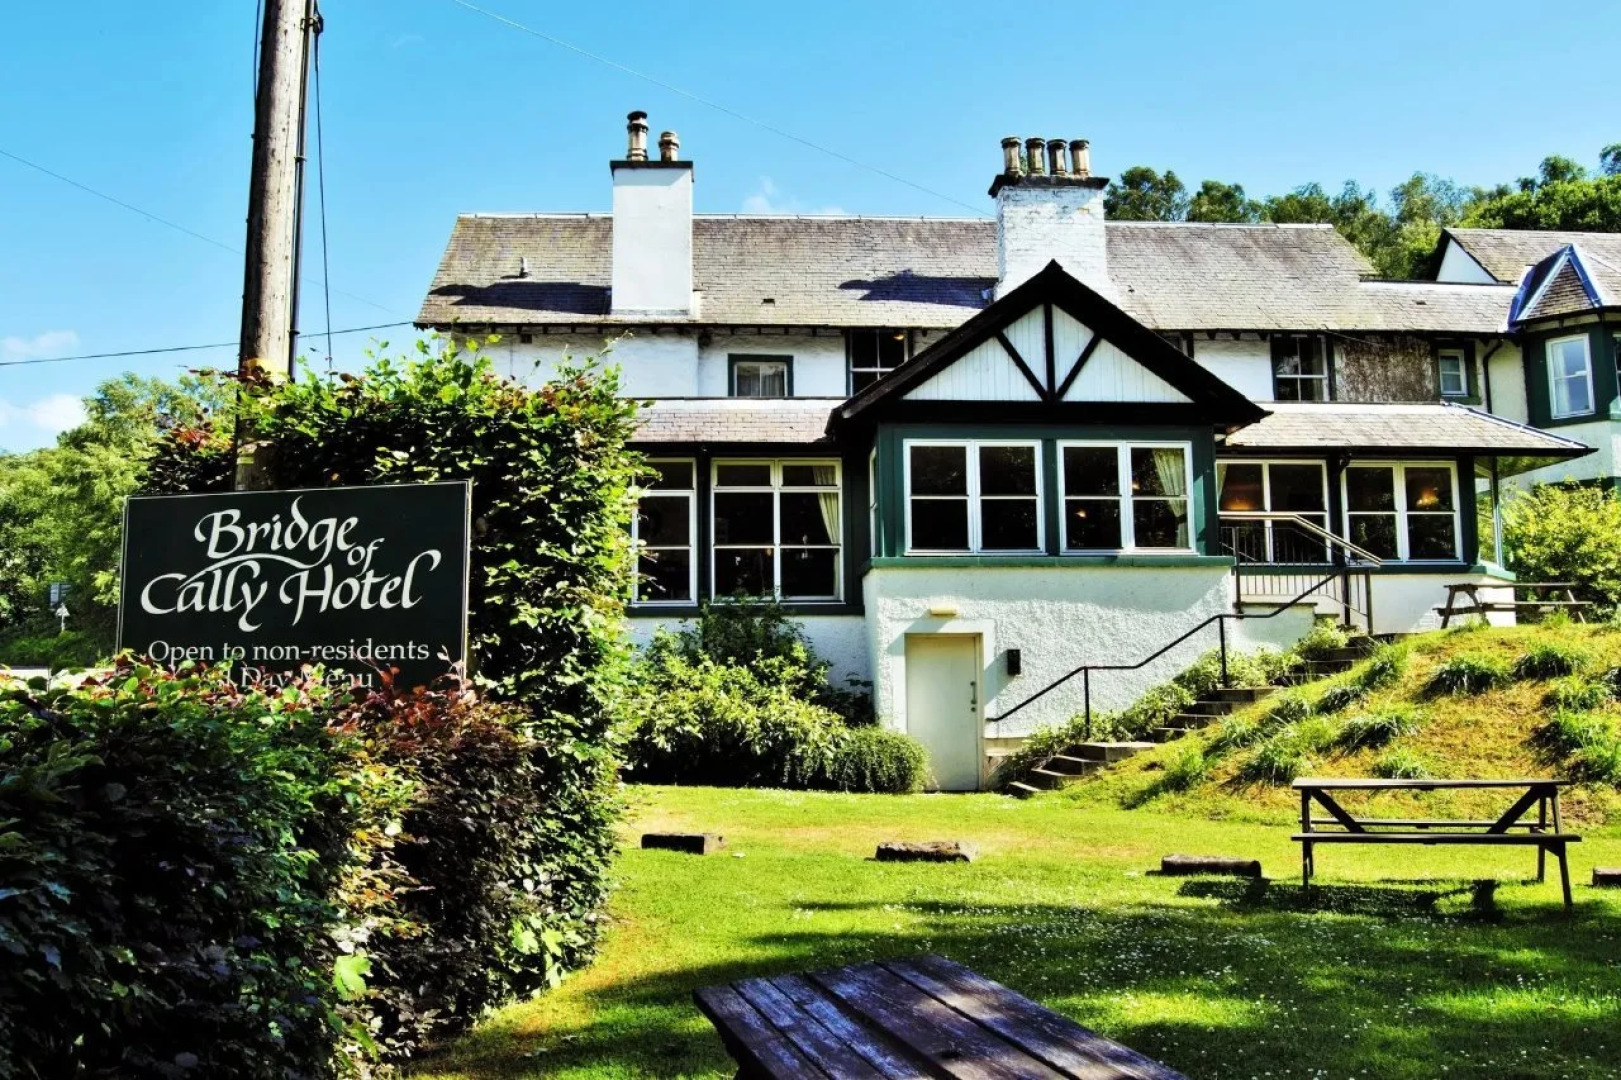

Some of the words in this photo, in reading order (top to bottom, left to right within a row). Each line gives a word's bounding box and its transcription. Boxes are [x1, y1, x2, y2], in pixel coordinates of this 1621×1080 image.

[193, 495, 360, 568] Bridge
[346, 536, 386, 577] of
[141, 559, 268, 632] Cally
[279, 549, 442, 626] Hotel
[148, 640, 214, 671] Open
[222, 642, 246, 661] to
[252, 637, 430, 661] non-residents
